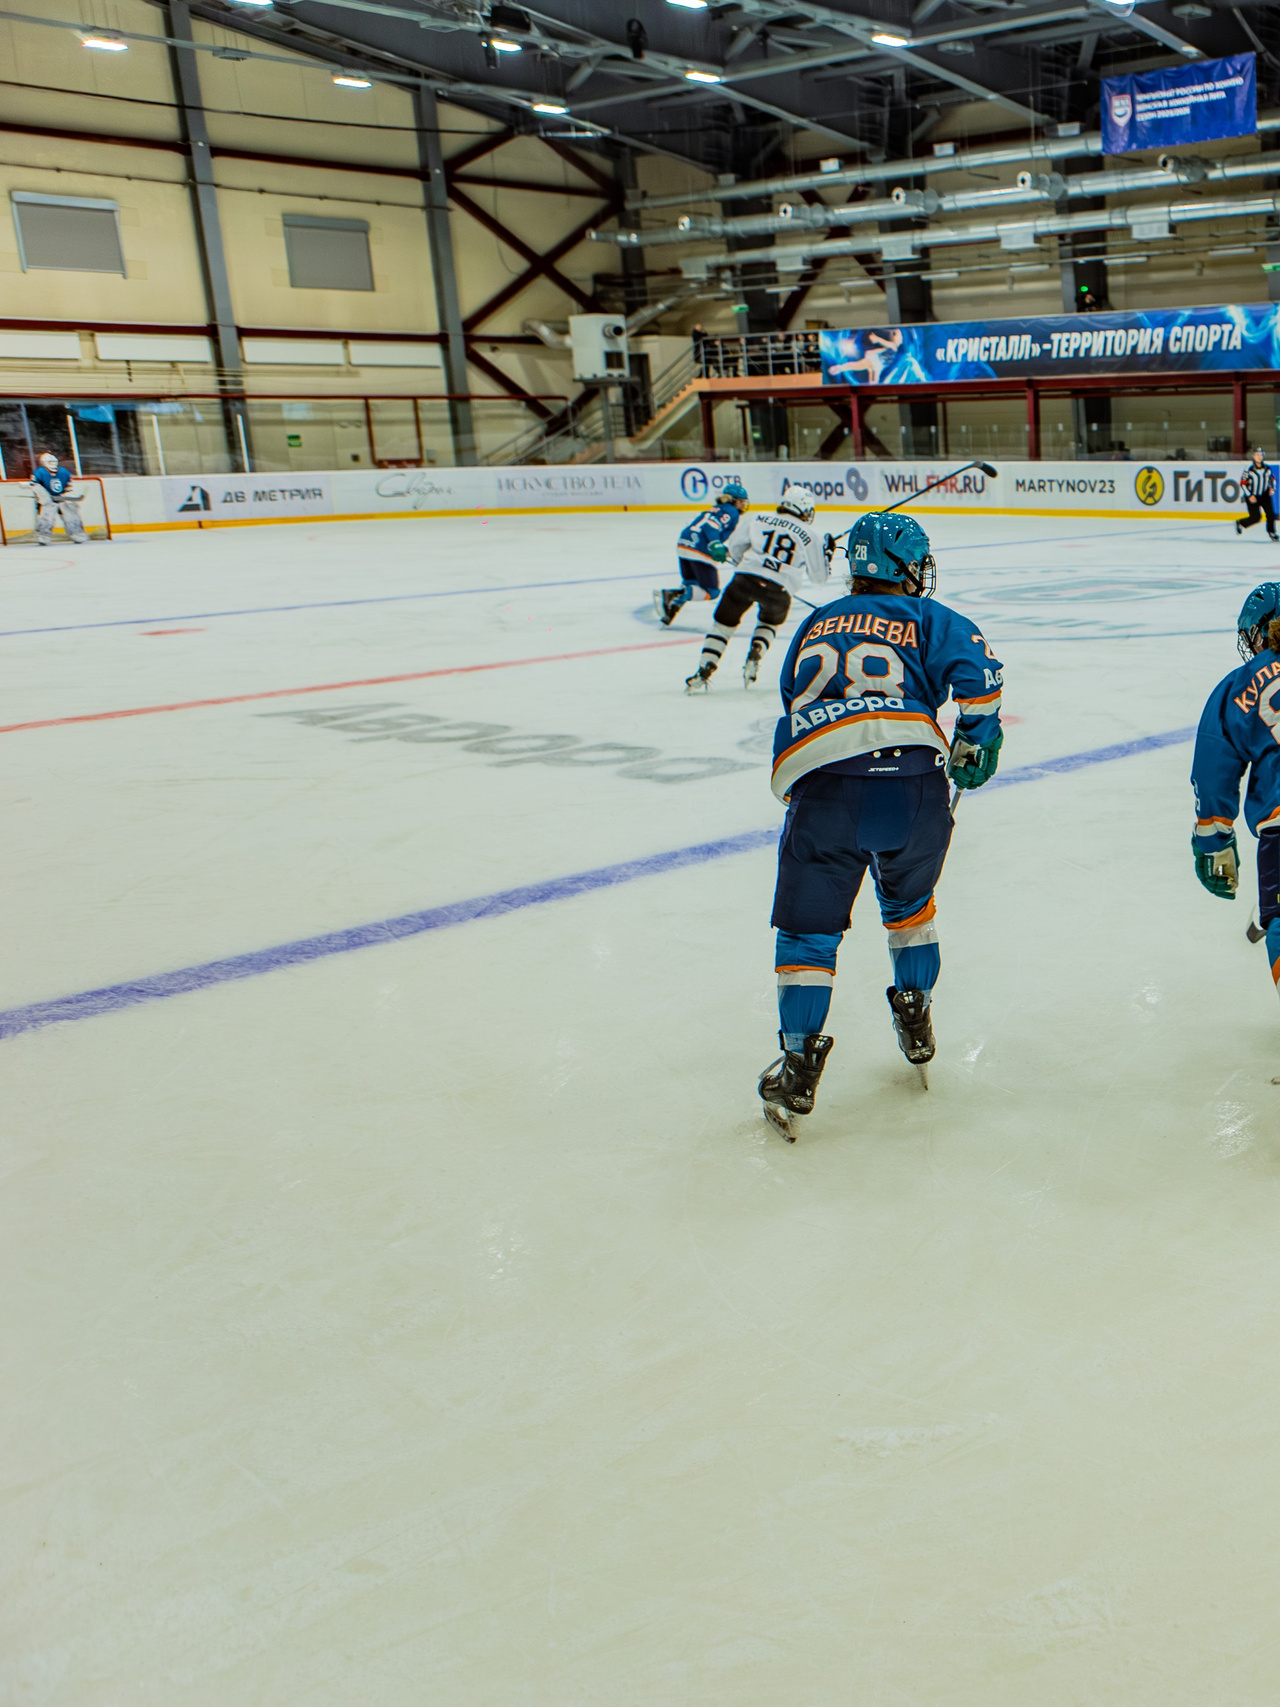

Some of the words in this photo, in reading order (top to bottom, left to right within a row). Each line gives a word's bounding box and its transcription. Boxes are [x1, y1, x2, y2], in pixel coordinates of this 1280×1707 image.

[1168, 323, 1243, 354] СПОРТА
[221, 490, 247, 504] ДВ
[253, 488, 324, 503] МЕТРИЯ
[603, 474, 642, 490] ТЕЛА
[1015, 479, 1116, 494] MARTYNOV23
[756, 515, 811, 547] МЕДЮТОВА
[762, 530, 797, 566] 18
[855, 544, 868, 561] 28
[790, 641, 905, 714] 28
[790, 696, 905, 738] Аврора
